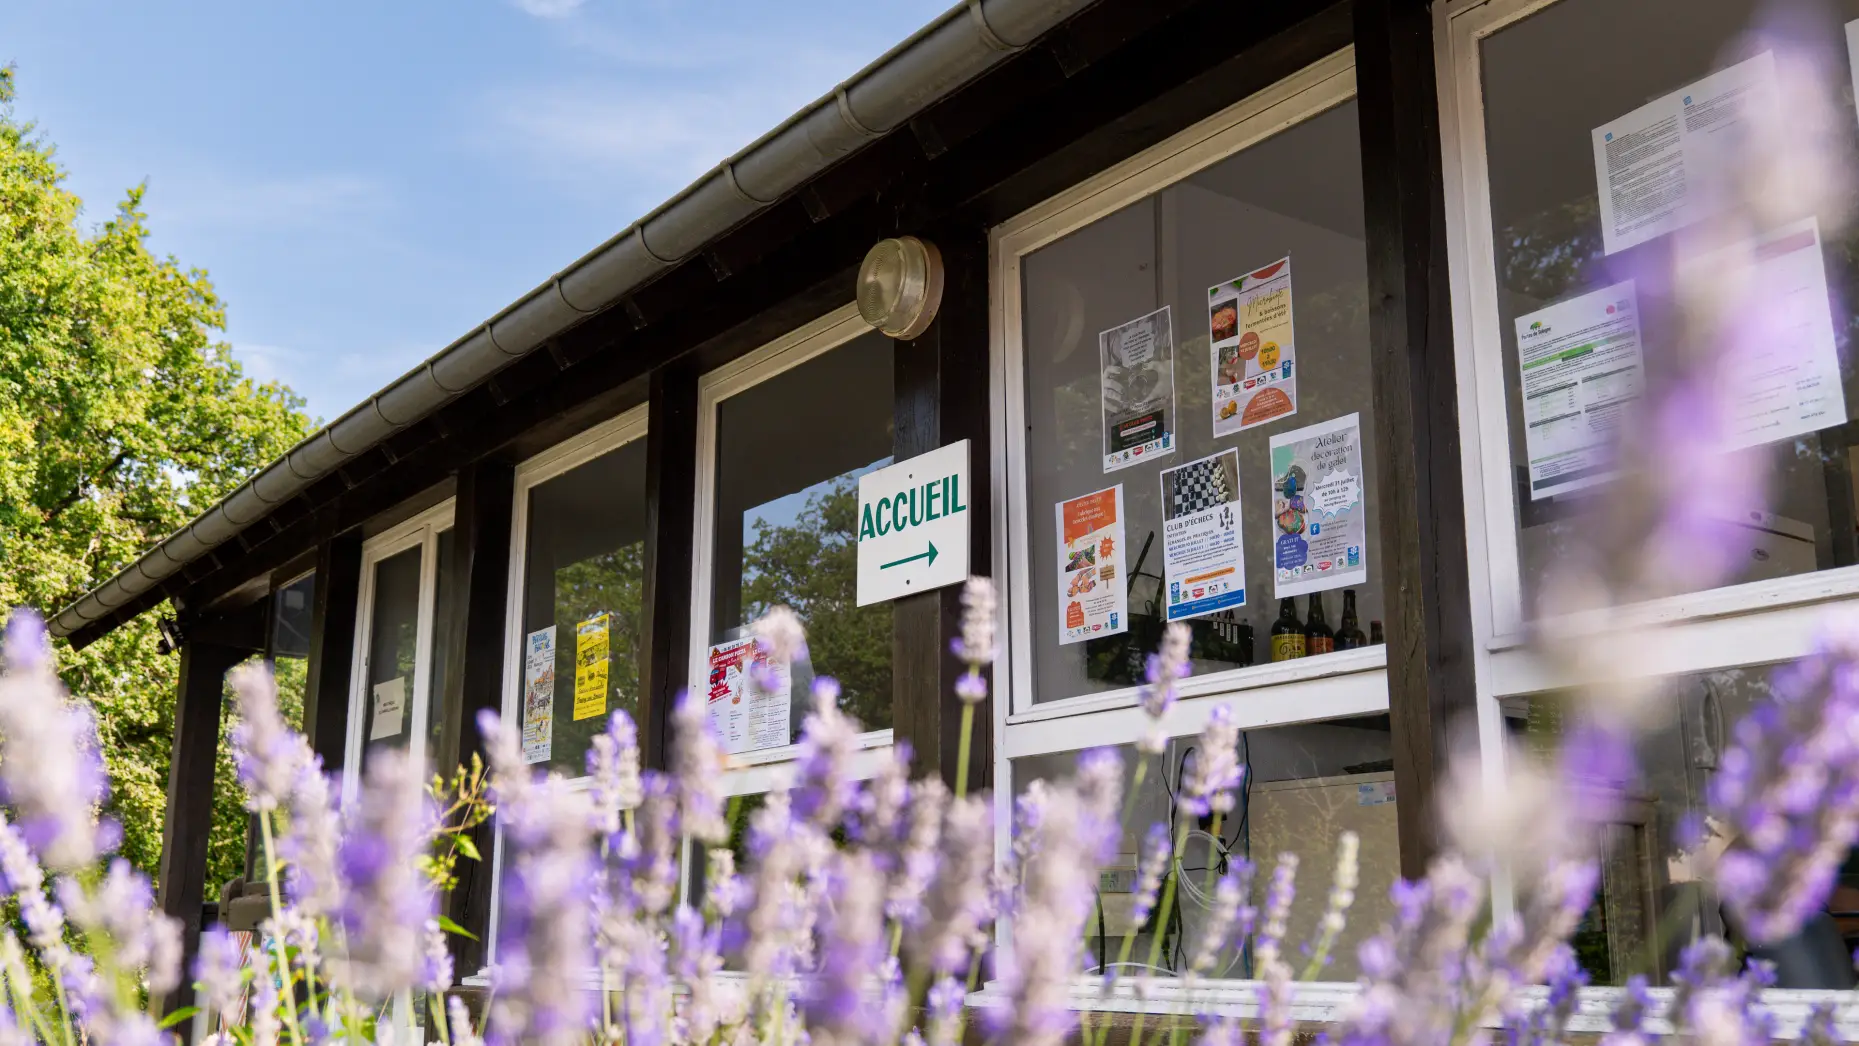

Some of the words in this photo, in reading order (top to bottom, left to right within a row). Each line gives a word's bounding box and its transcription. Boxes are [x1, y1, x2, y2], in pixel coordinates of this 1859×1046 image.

[1315, 434, 1347, 448] Atelier
[1316, 461, 1326, 470] de
[1328, 456, 1347, 470] galet
[1315, 481, 1335, 491] Mercredi
[859, 473, 967, 543] ACCUEIL
[1166, 522, 1183, 532] CLUB
[1184, 513, 1214, 528] D'ÉCHECS
